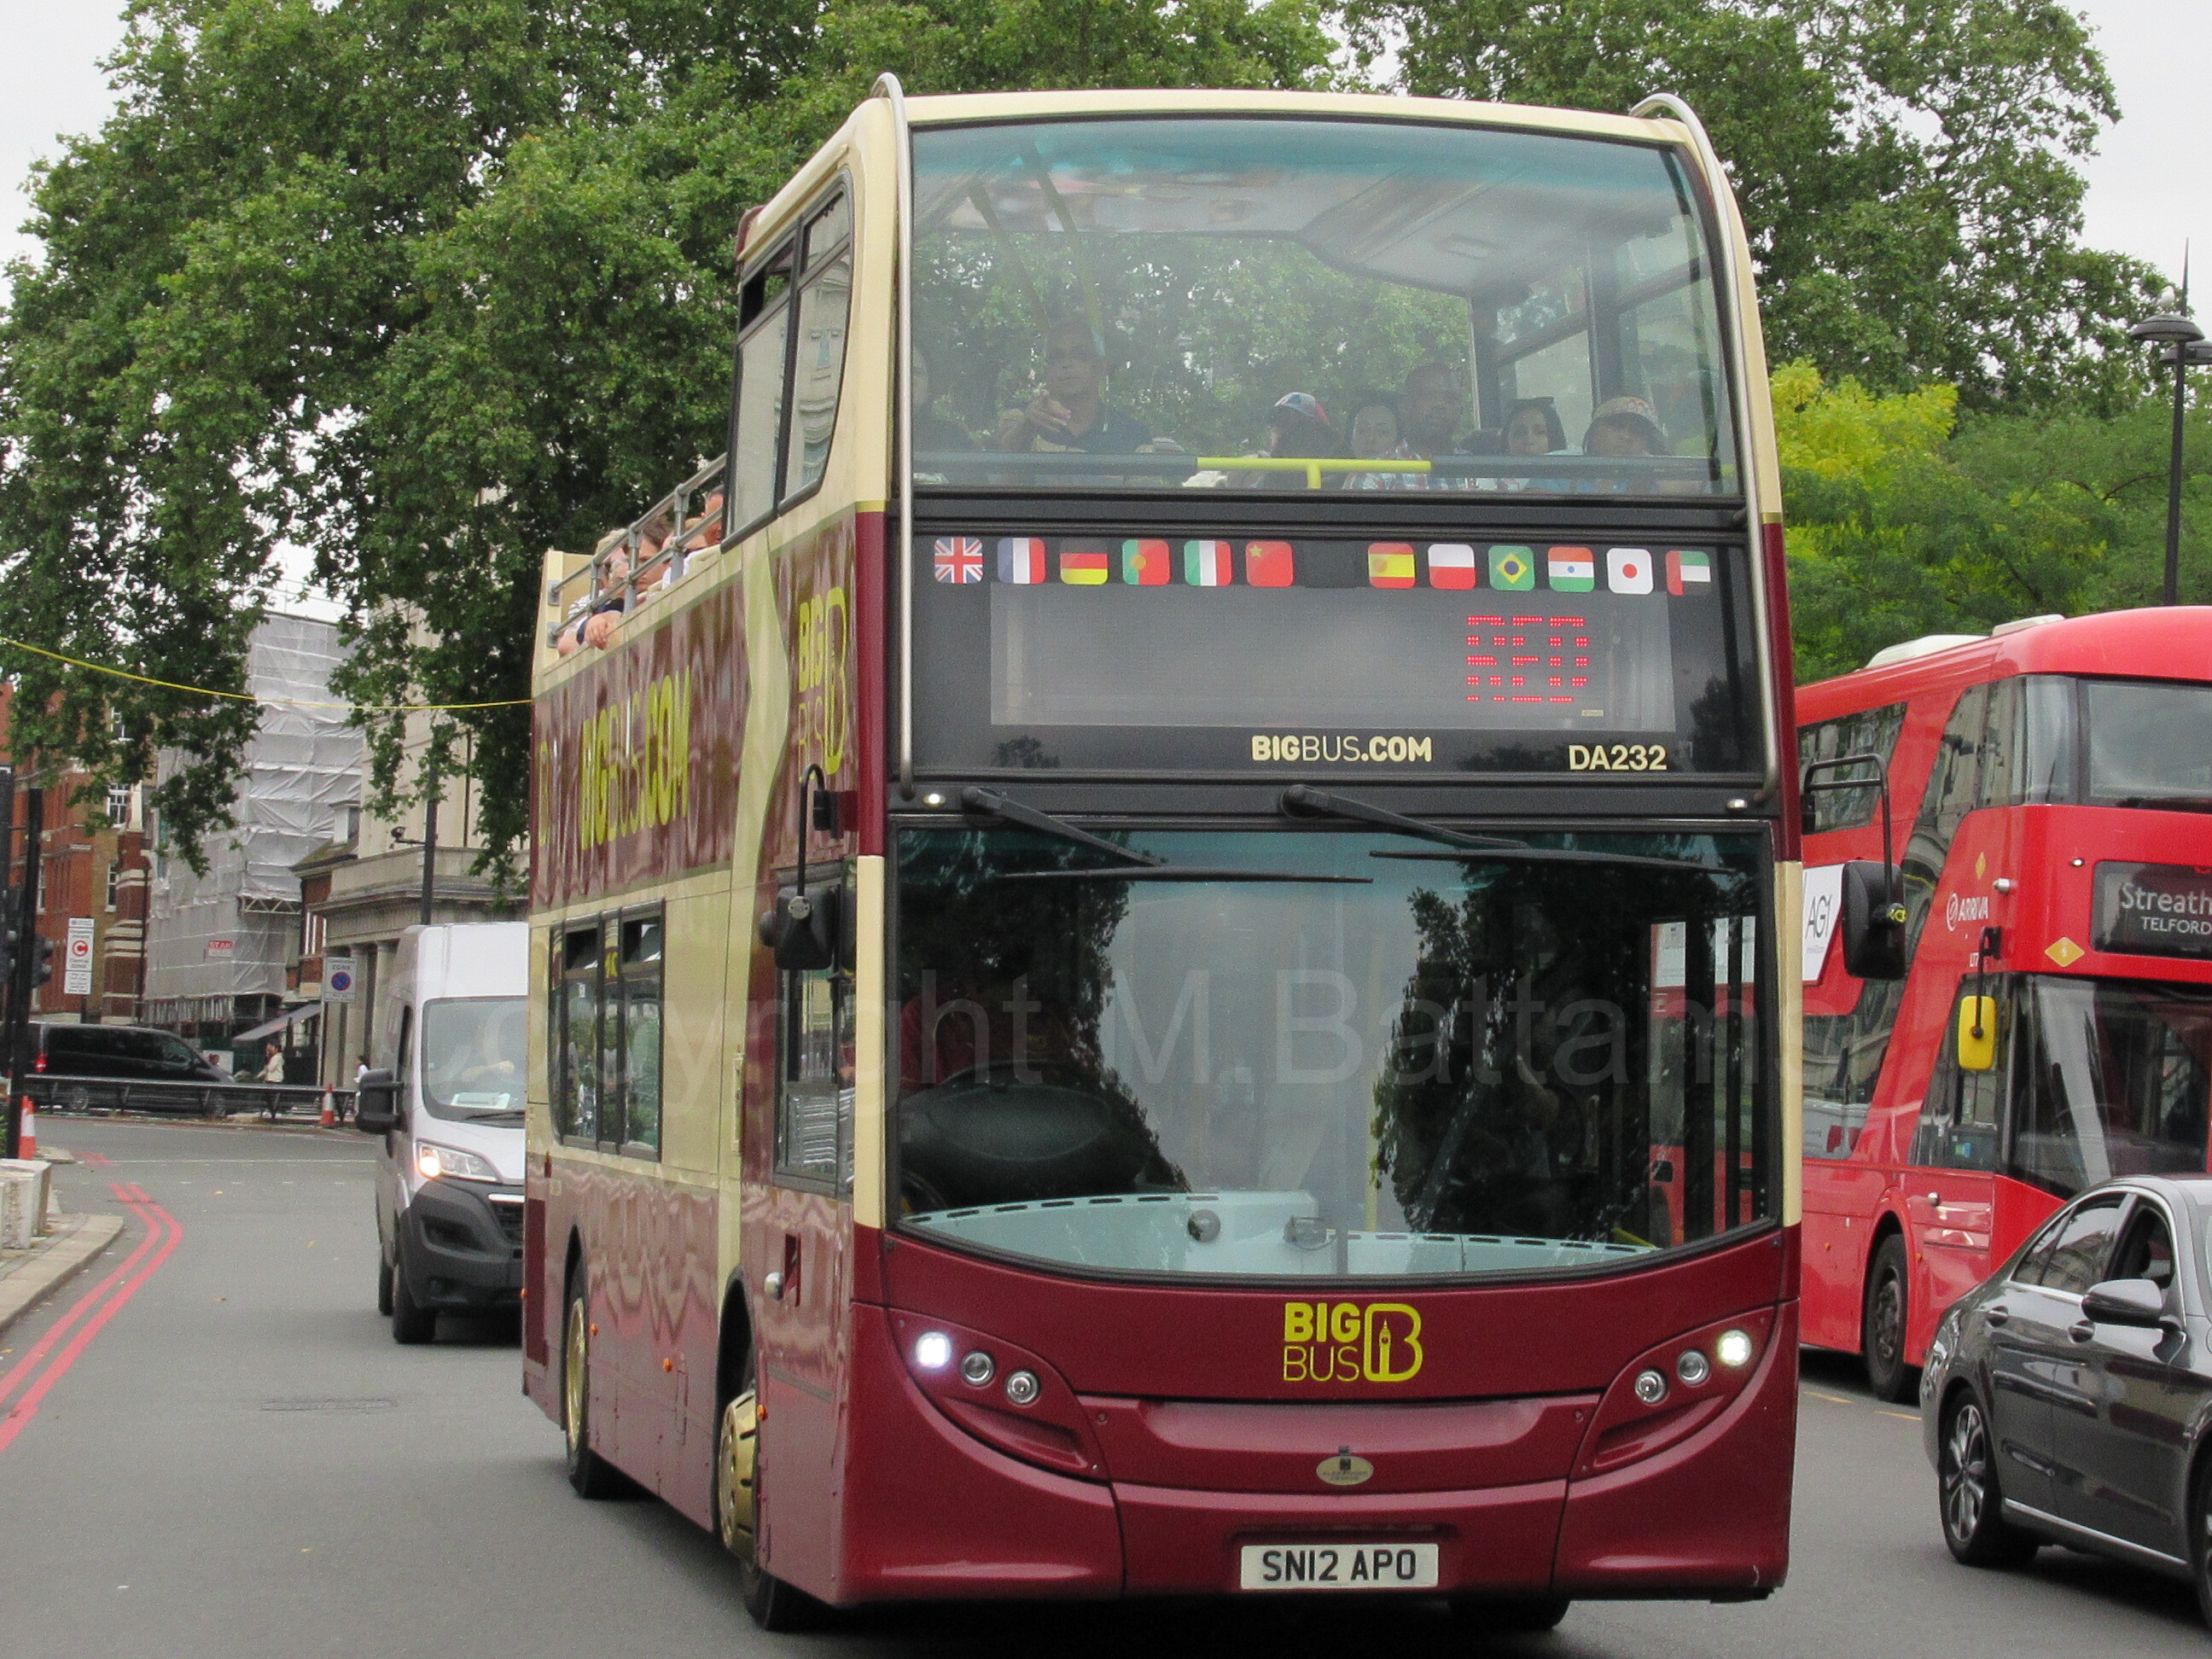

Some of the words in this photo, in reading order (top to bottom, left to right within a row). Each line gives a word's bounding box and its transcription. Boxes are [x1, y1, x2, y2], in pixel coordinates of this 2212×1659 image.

[1251, 735, 1433, 762] BIGBUS.COM
[1569, 744, 1668, 771] DA232
[2140, 916, 2212, 935] TELFORD
[1284, 1301, 1360, 1342] BIG
[1283, 1346, 1359, 1382] BUS
[1262, 1549, 1339, 1581] SN12
[1350, 1549, 1417, 1580] APO
